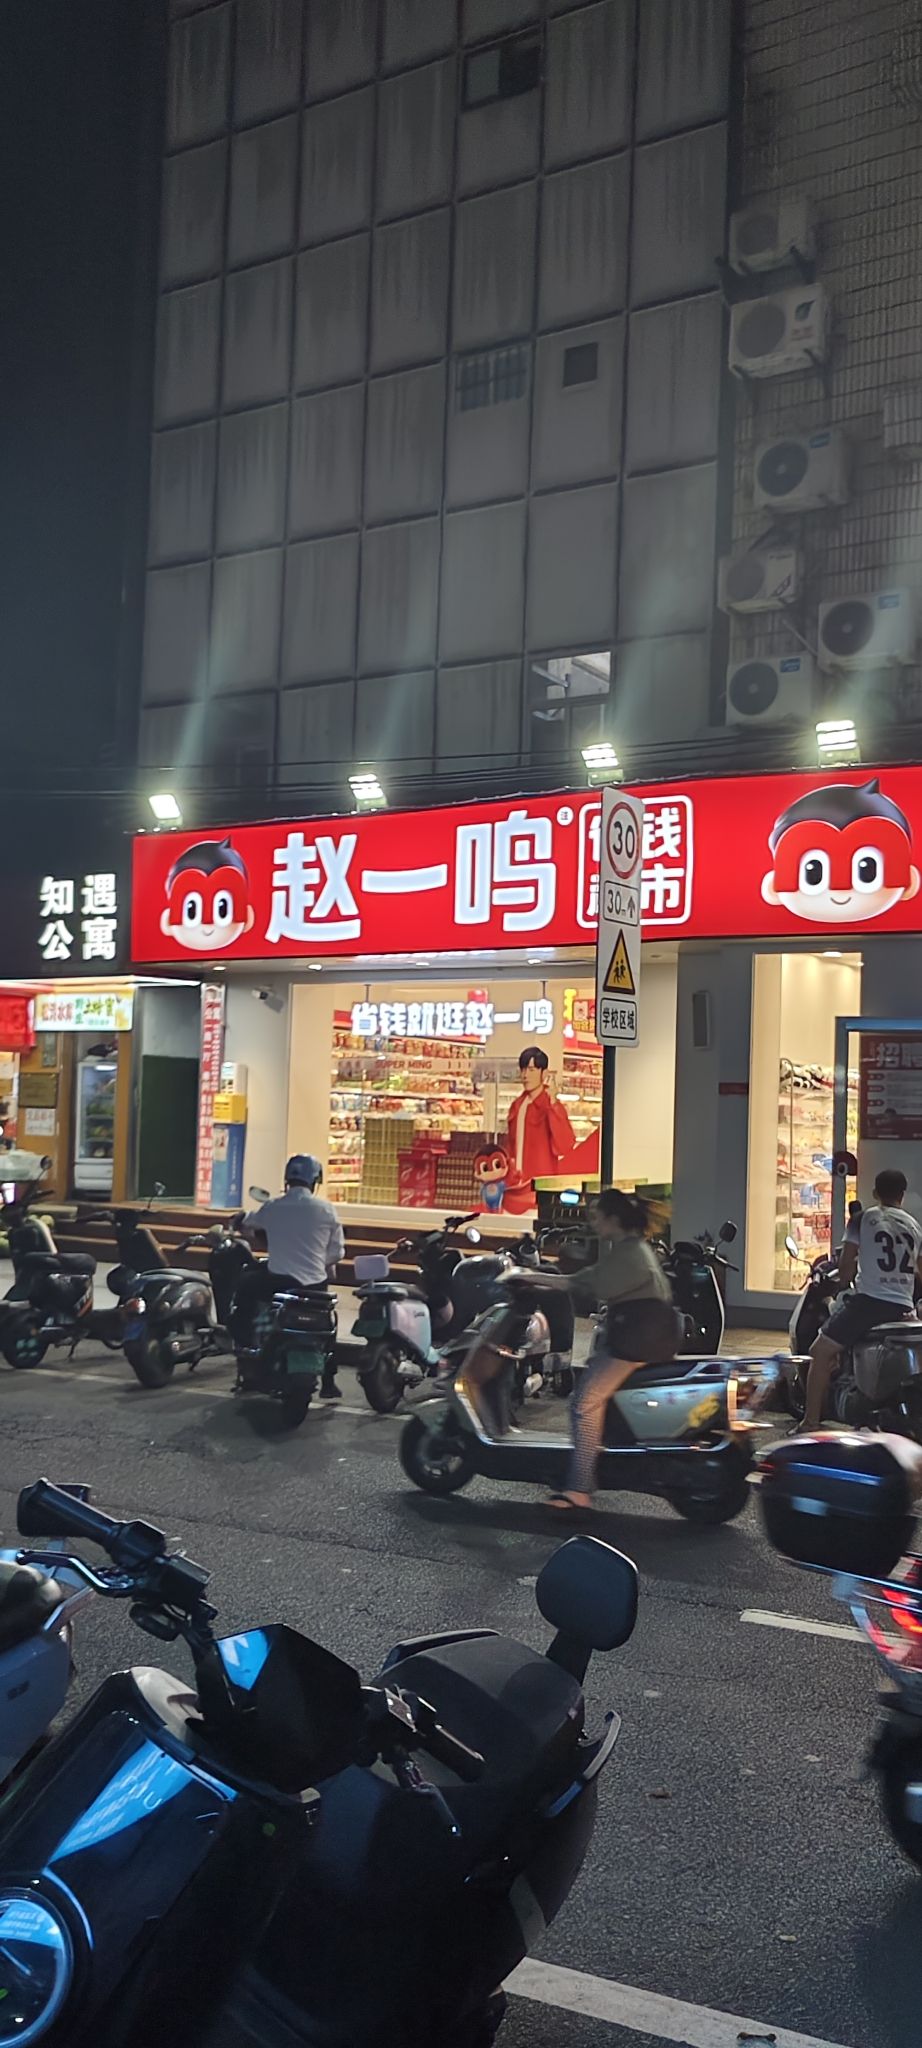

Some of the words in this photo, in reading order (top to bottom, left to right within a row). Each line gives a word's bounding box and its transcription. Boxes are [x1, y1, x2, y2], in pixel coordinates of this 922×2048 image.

[588, 807, 682, 862] 钱
[612, 820, 635, 859] 30
[40, 873, 118, 917] 知遇
[265, 810, 557, 943] 赵一鸣
[586, 863, 685, 916] 市
[38, 916, 118, 960] 公寓
[350, 999, 555, 1037] 省钱就逛赵一鸣
[602, 1007, 635, 1031] 学校区域
[874, 1230, 915, 1275] 32
